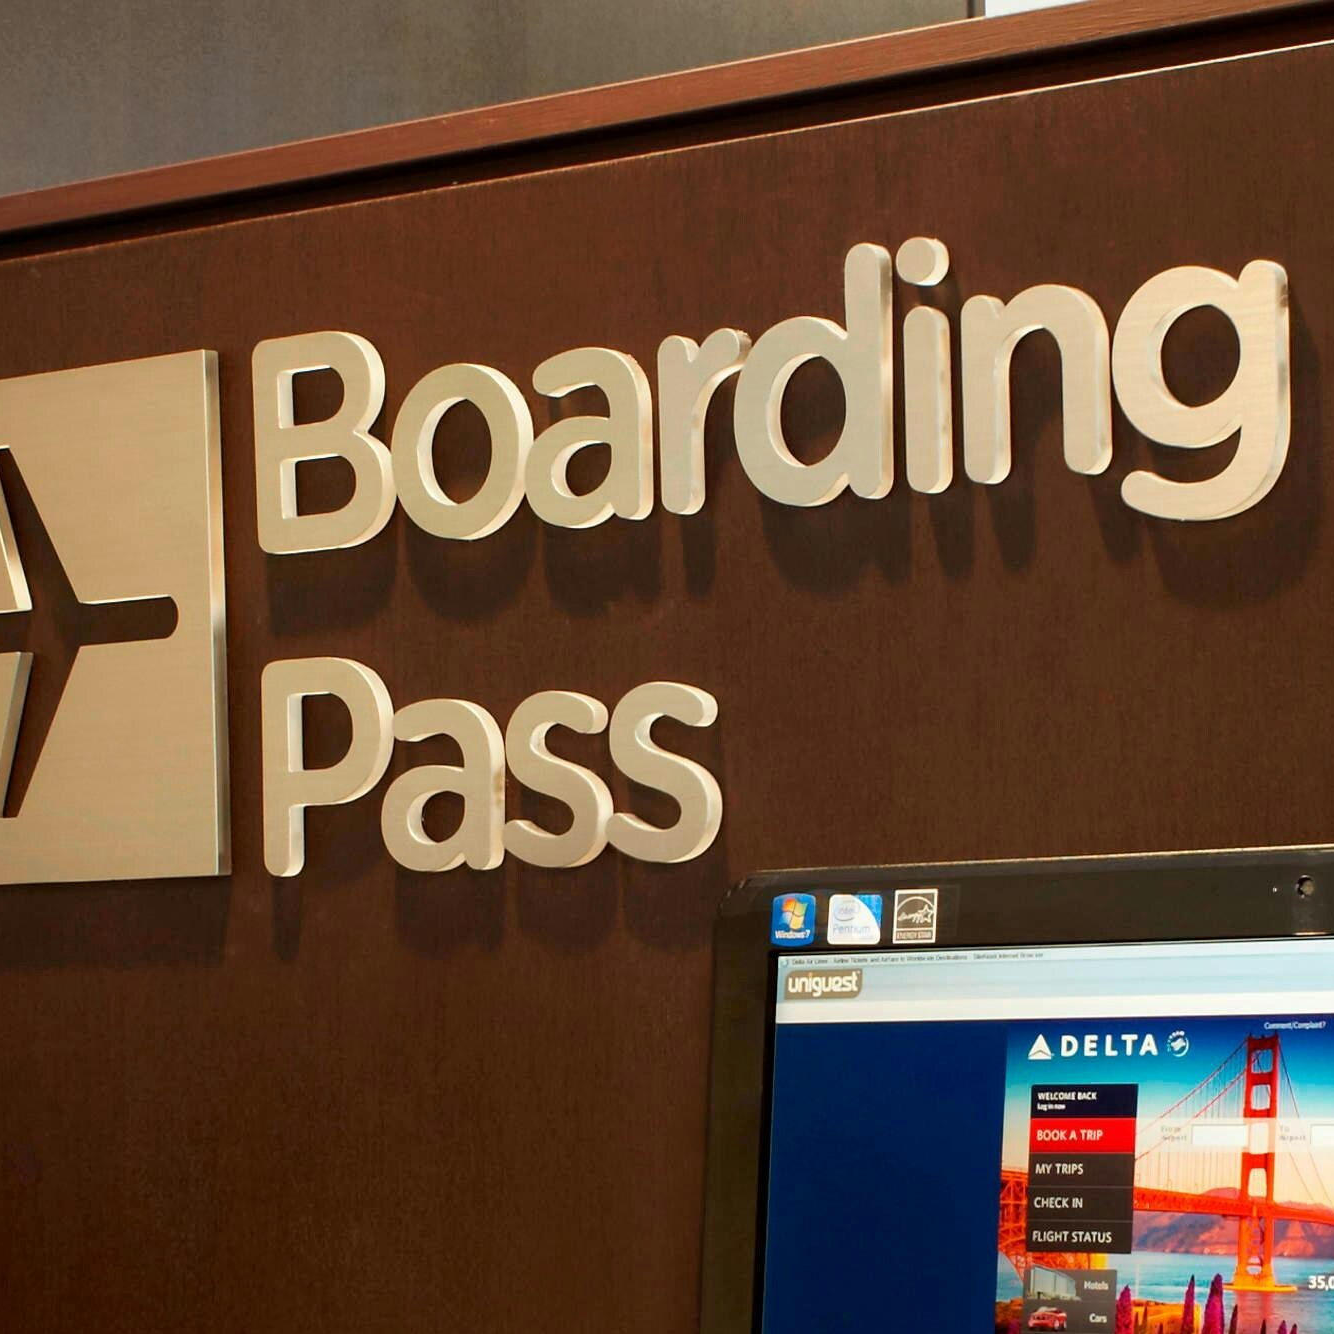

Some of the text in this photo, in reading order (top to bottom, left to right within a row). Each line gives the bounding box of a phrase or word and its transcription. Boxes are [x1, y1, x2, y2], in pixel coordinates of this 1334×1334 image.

[252, 236, 1289, 555] Boarding
[259, 656, 723, 877] Pass
[788, 972, 859, 996] uniguest
[1061, 1034, 1158, 1056] DELTA
[1038, 1092, 1096, 1100] WELCOME BACK
[1037, 1129, 1103, 1141] BOOK A TRIP
[1035, 1163, 1083, 1174] MY TRIPS
[1034, 1197, 1083, 1208] CHECK IN
[1033, 1231, 1112, 1243] FLIGHT STATUS
[1084, 1281, 1109, 1290] Hotels
[1089, 1313, 1107, 1323] Cars
